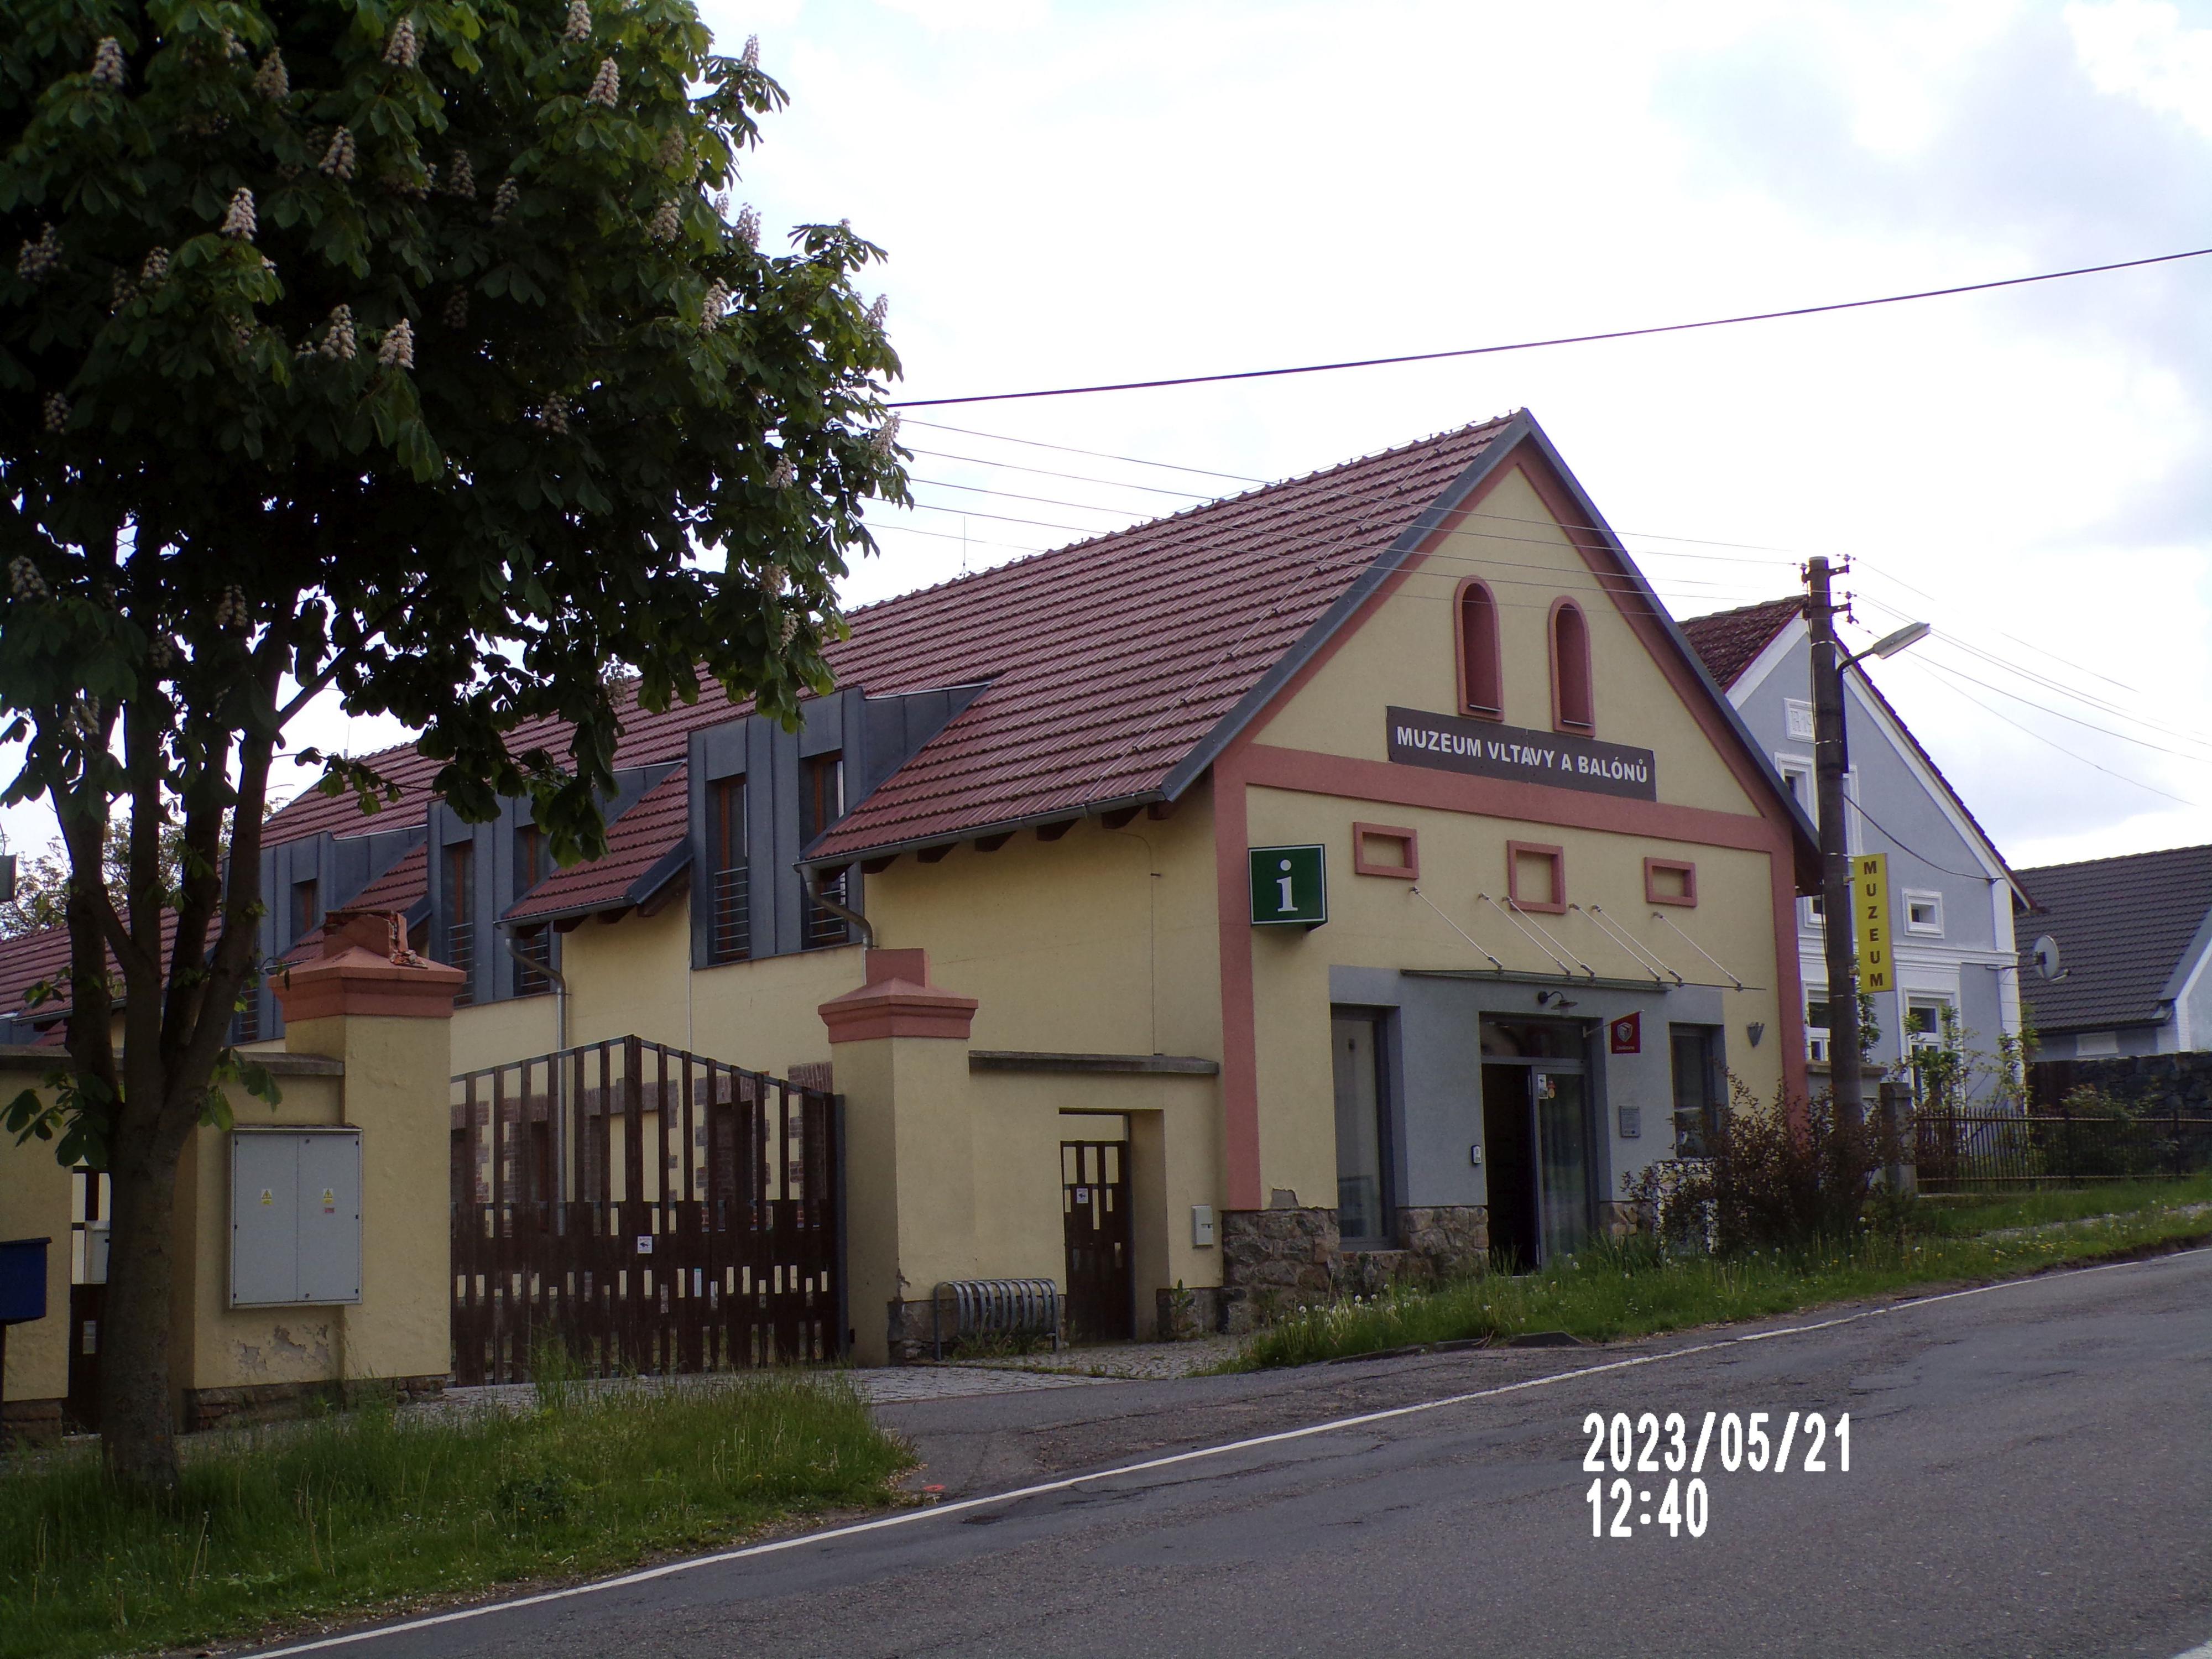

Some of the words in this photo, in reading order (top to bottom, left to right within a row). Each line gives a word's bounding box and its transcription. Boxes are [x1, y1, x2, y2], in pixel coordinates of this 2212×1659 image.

[1397, 726, 1481, 758] MUZEUM
[1488, 741, 1554, 768] VLTAVY
[1561, 753, 1573, 771] A
[1578, 755, 1647, 782] BALÓNŮ
[1276, 859, 1298, 912] i
[1863, 860, 1884, 987] MUZEUM
